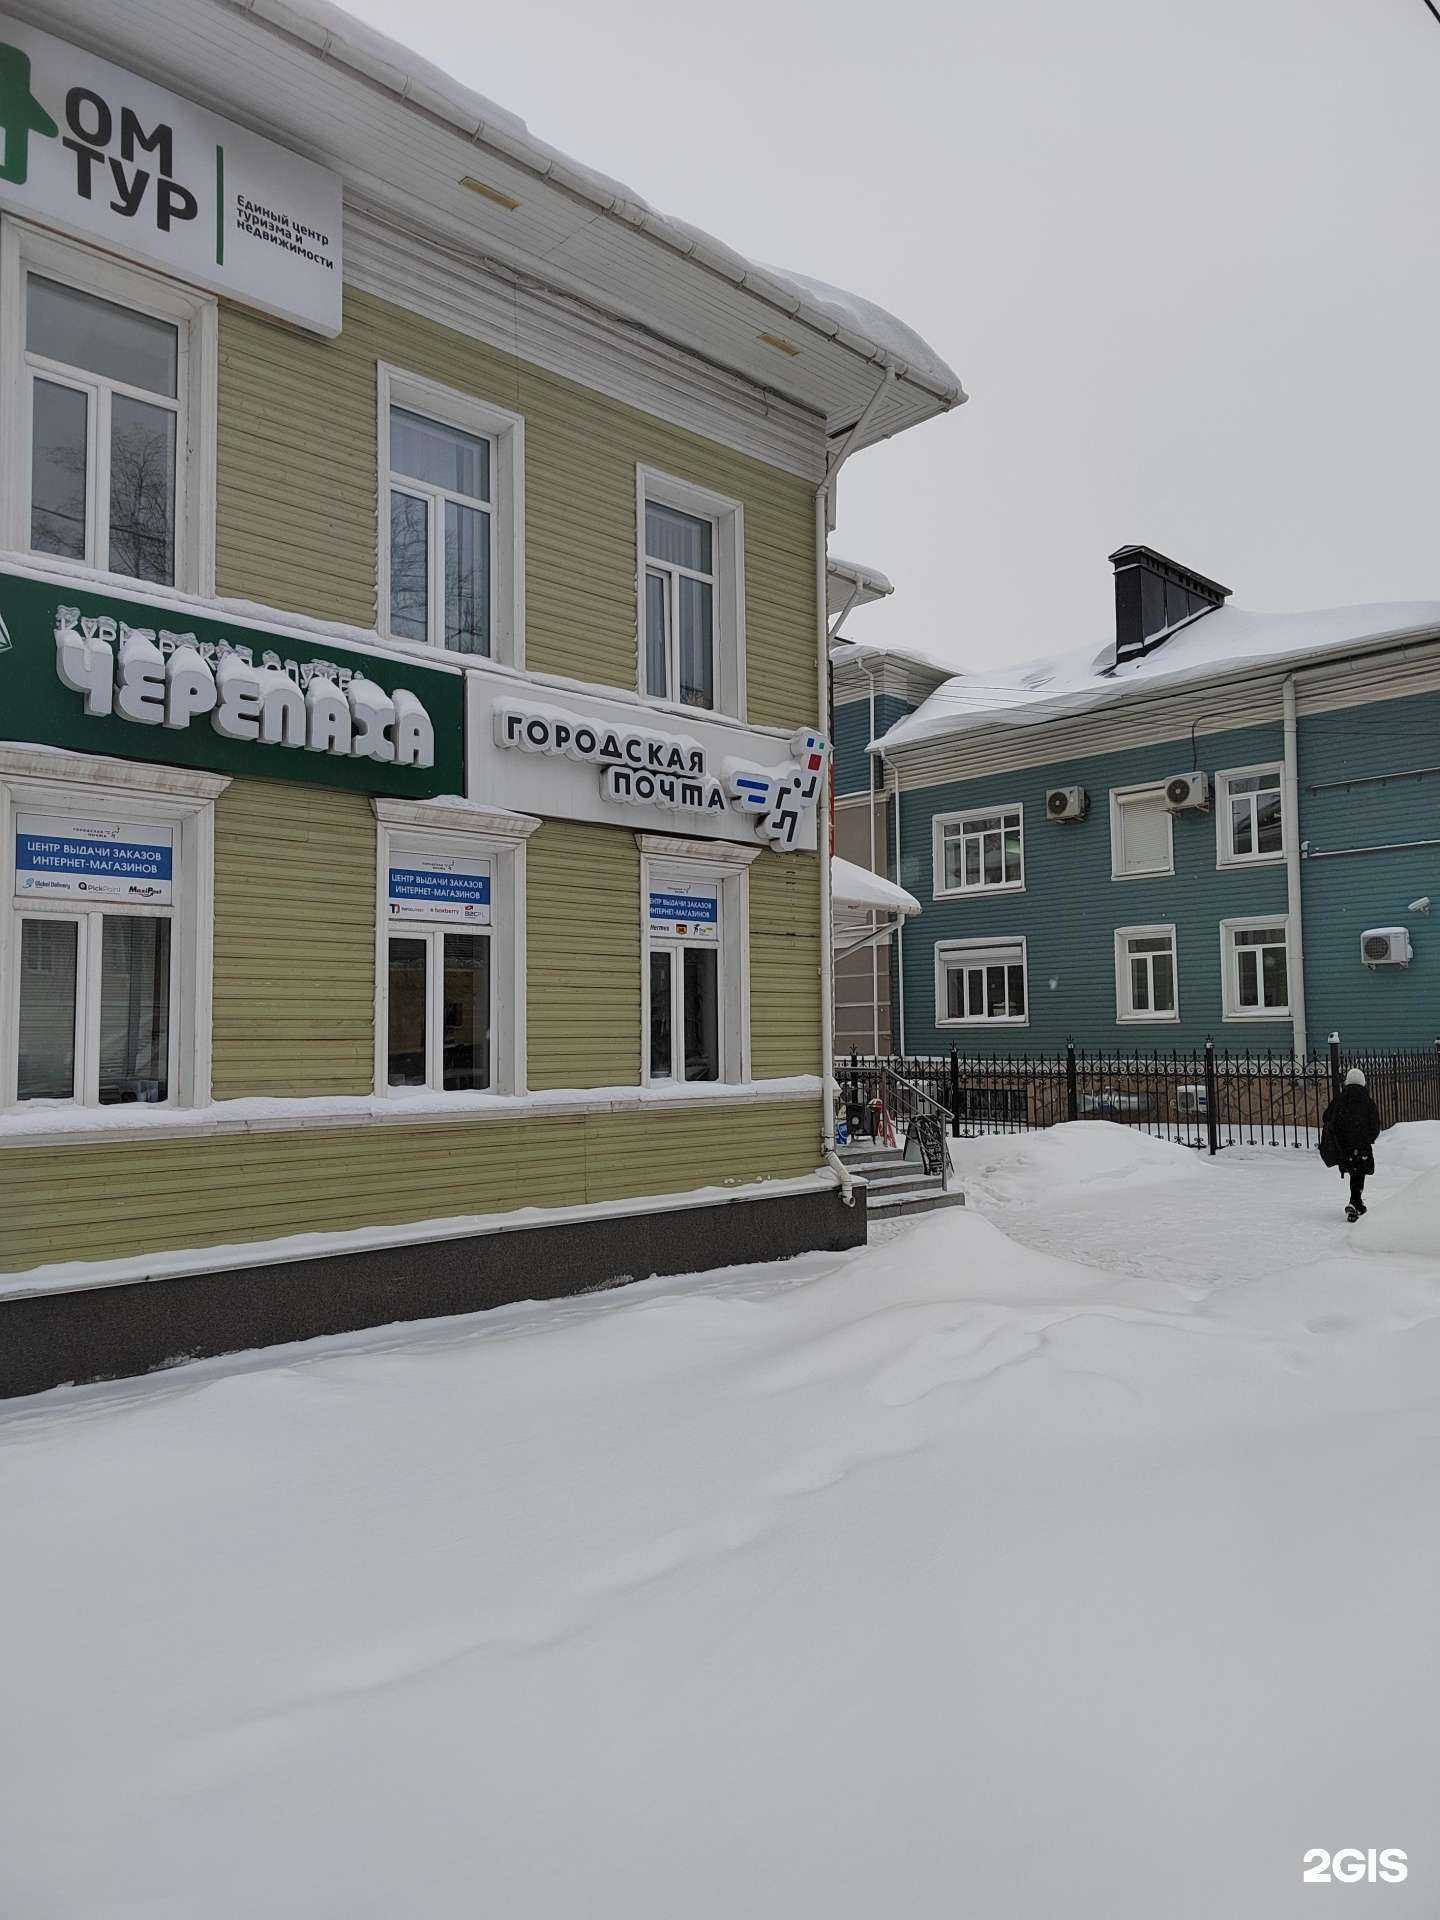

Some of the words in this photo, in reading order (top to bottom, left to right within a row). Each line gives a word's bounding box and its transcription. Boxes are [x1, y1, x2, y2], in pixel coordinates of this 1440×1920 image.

[62, 136, 198, 233] ТУР
[236, 207, 292, 240] туризма
[295, 234, 303, 245] и
[237, 194, 289, 227] Единый
[292, 222, 329, 246] центр
[236, 219, 334, 270] недвижимости
[56, 632, 435, 768] ЧЕРЕПАХА
[507, 715, 704, 774] ГОРОДСКАЯ
[613, 772, 725, 811] ПОЧТА
[27, 841, 61, 853] ЦЕНТР
[63, 844, 110, 857] ВЫДАЧИ
[113, 848, 161, 862] ЗАКАЗОВ
[32, 855, 158, 874] ИНТЕРНЕТ-МАГАЗИНОВ
[128, 885, 162, 897] MaxiPost
[391, 873, 415, 883] ЦЕНТР
[416, 876, 448, 886] ВЫДАЧИ
[449, 878, 484, 889] ЗАКАЗОВ
[395, 885, 481, 899] ИНТЕРНЕТ-МАГАЗИНОВ
